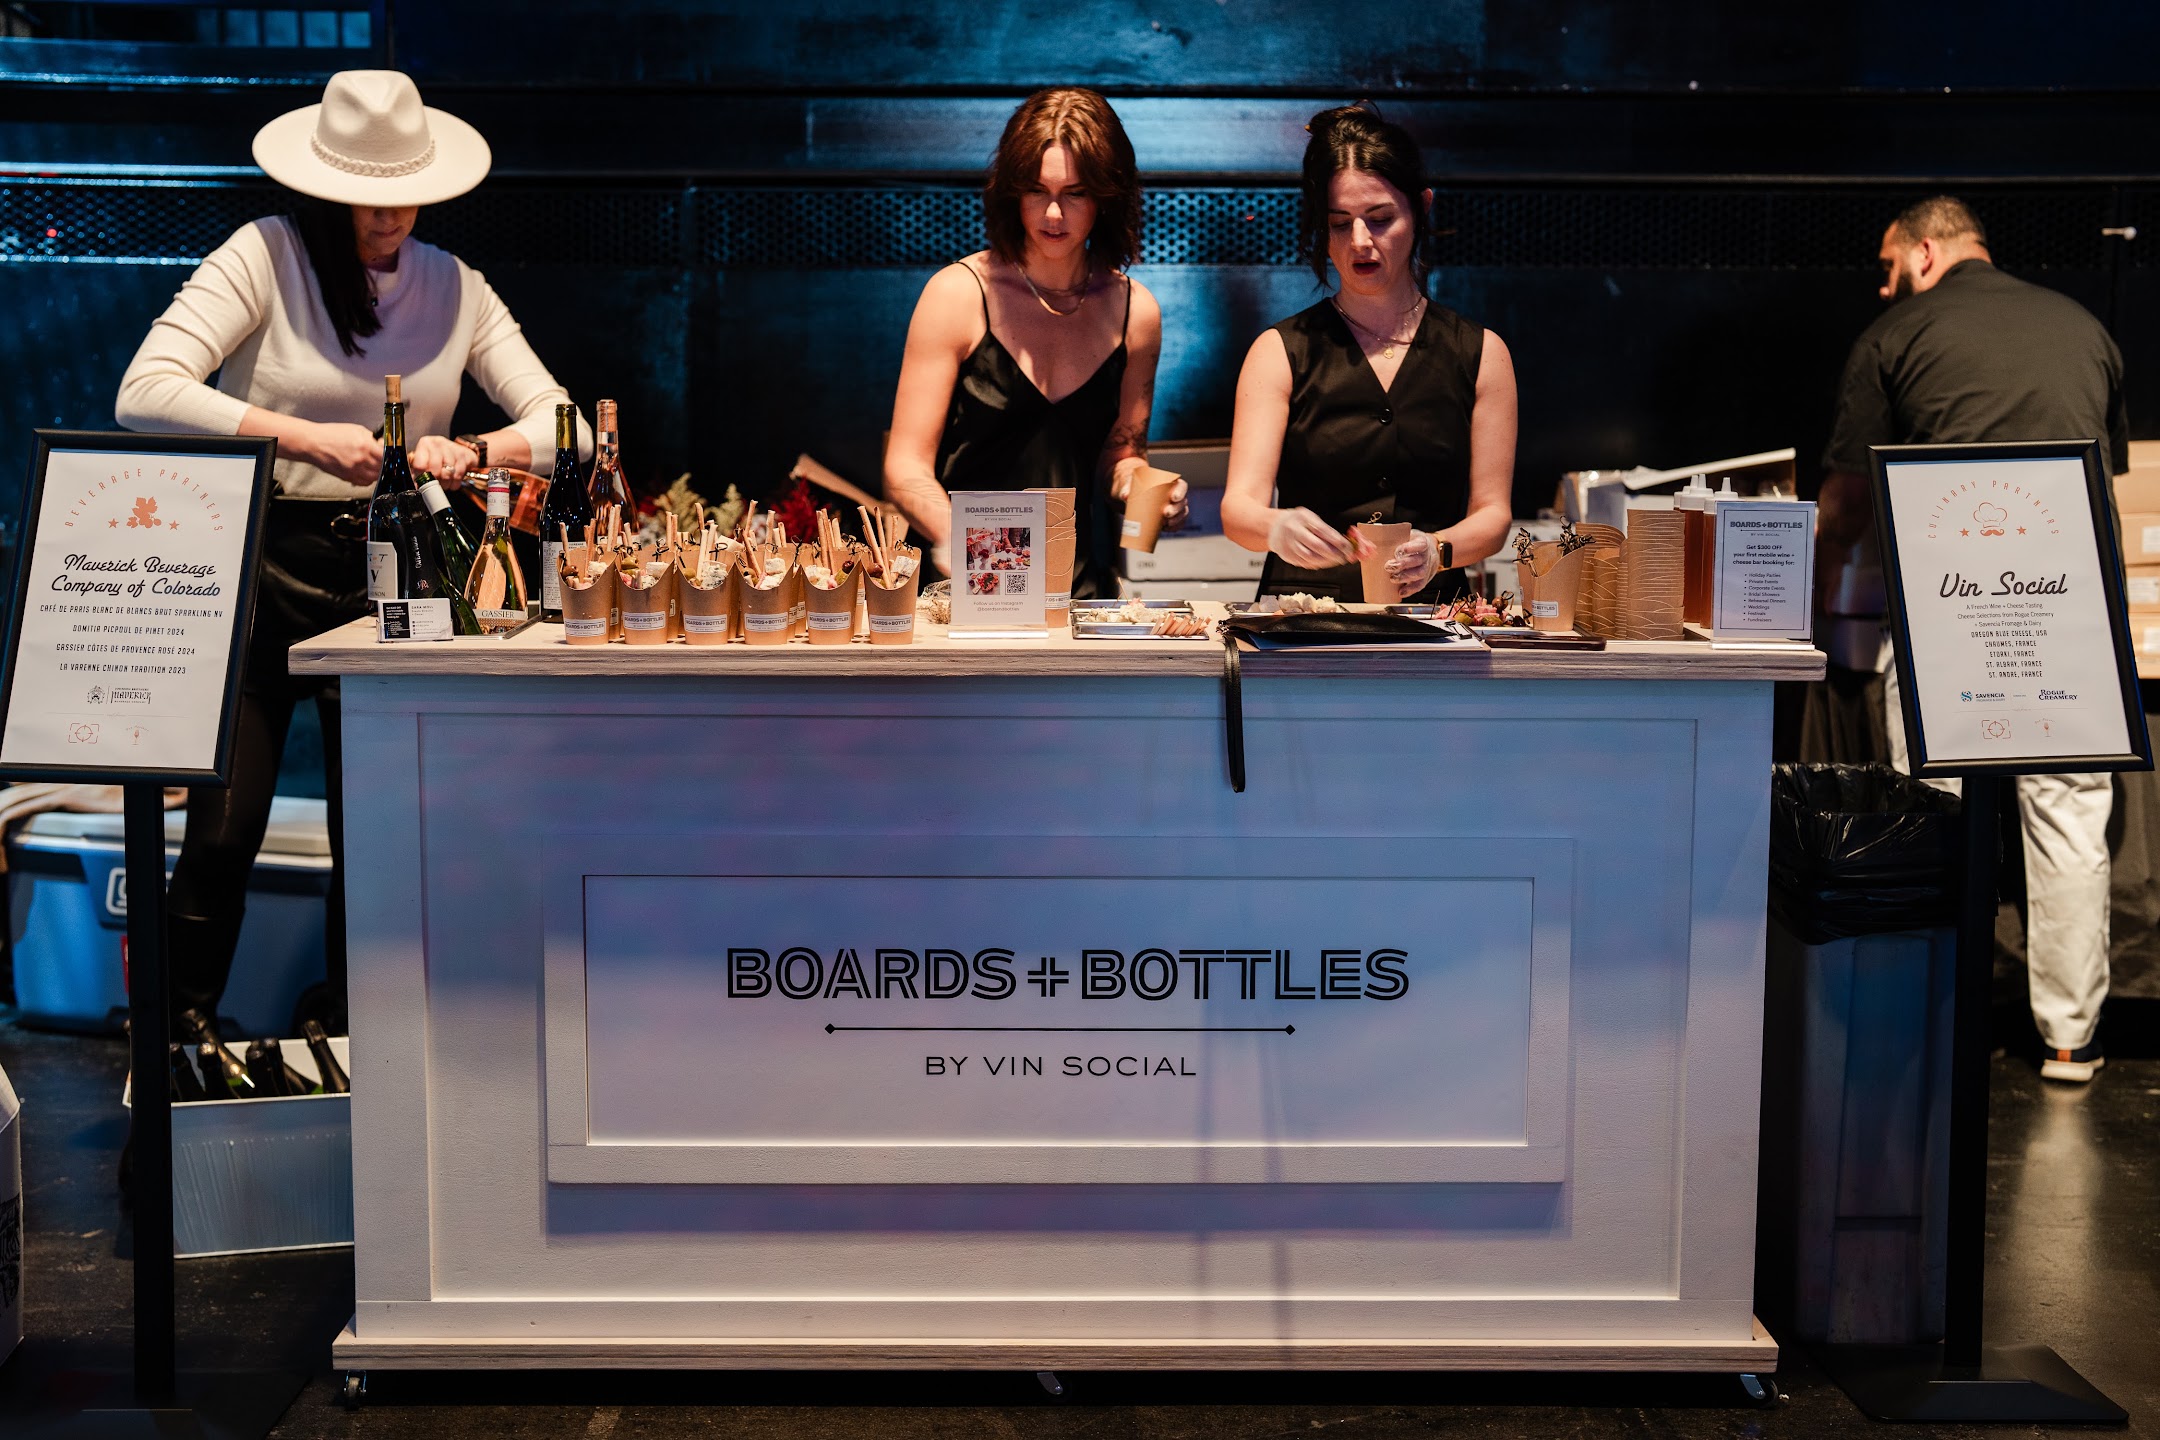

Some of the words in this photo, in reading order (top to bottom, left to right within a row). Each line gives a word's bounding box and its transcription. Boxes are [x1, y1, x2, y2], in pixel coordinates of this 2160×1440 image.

[65, 468, 141, 527] BEVERAGE
[159, 469, 223, 531] PARTNERS
[1928, 481, 1976, 538] CULINARY
[1992, 480, 2059, 534] PARTNERS
[64, 554, 137, 572] Maverick
[144, 556, 216, 578] Beverage
[51, 574, 122, 596] Company
[128, 579, 145, 597] of
[152, 578, 220, 596] Colorado
[1940, 573, 1982, 598] Vin
[1991, 571, 2068, 595] Social
[40, 604, 56, 612] CAFÉ
[92, 606, 113, 614] BLANC
[127, 607, 152, 615] BLANCS
[155, 608, 172, 616] BRUT
[174, 609, 211, 617] SPARKLING
[214, 610, 223, 618] NV
[482, 610, 515, 618] GASSIER
[103, 626, 132, 634] PICPOUL
[146, 627, 164, 635] PINET
[167, 628, 184, 636] 2024
[56, 643, 84, 652] GASSIER
[87, 643, 108, 652] CÔTES
[121, 646, 156, 654] PROVENCE
[158, 645, 176, 654] ROSÉ
[178, 647, 195, 655] 2024
[70, 664, 100, 672] VARENNE
[102, 664, 128, 672] CHINON
[131, 665, 166, 674] TRADITION
[168, 666, 186, 674] 2023
[925, 1056, 968, 1076] BY
[982, 1056, 1044, 1076] VIN
[1061, 1055, 1197, 1077] SOCIAL
